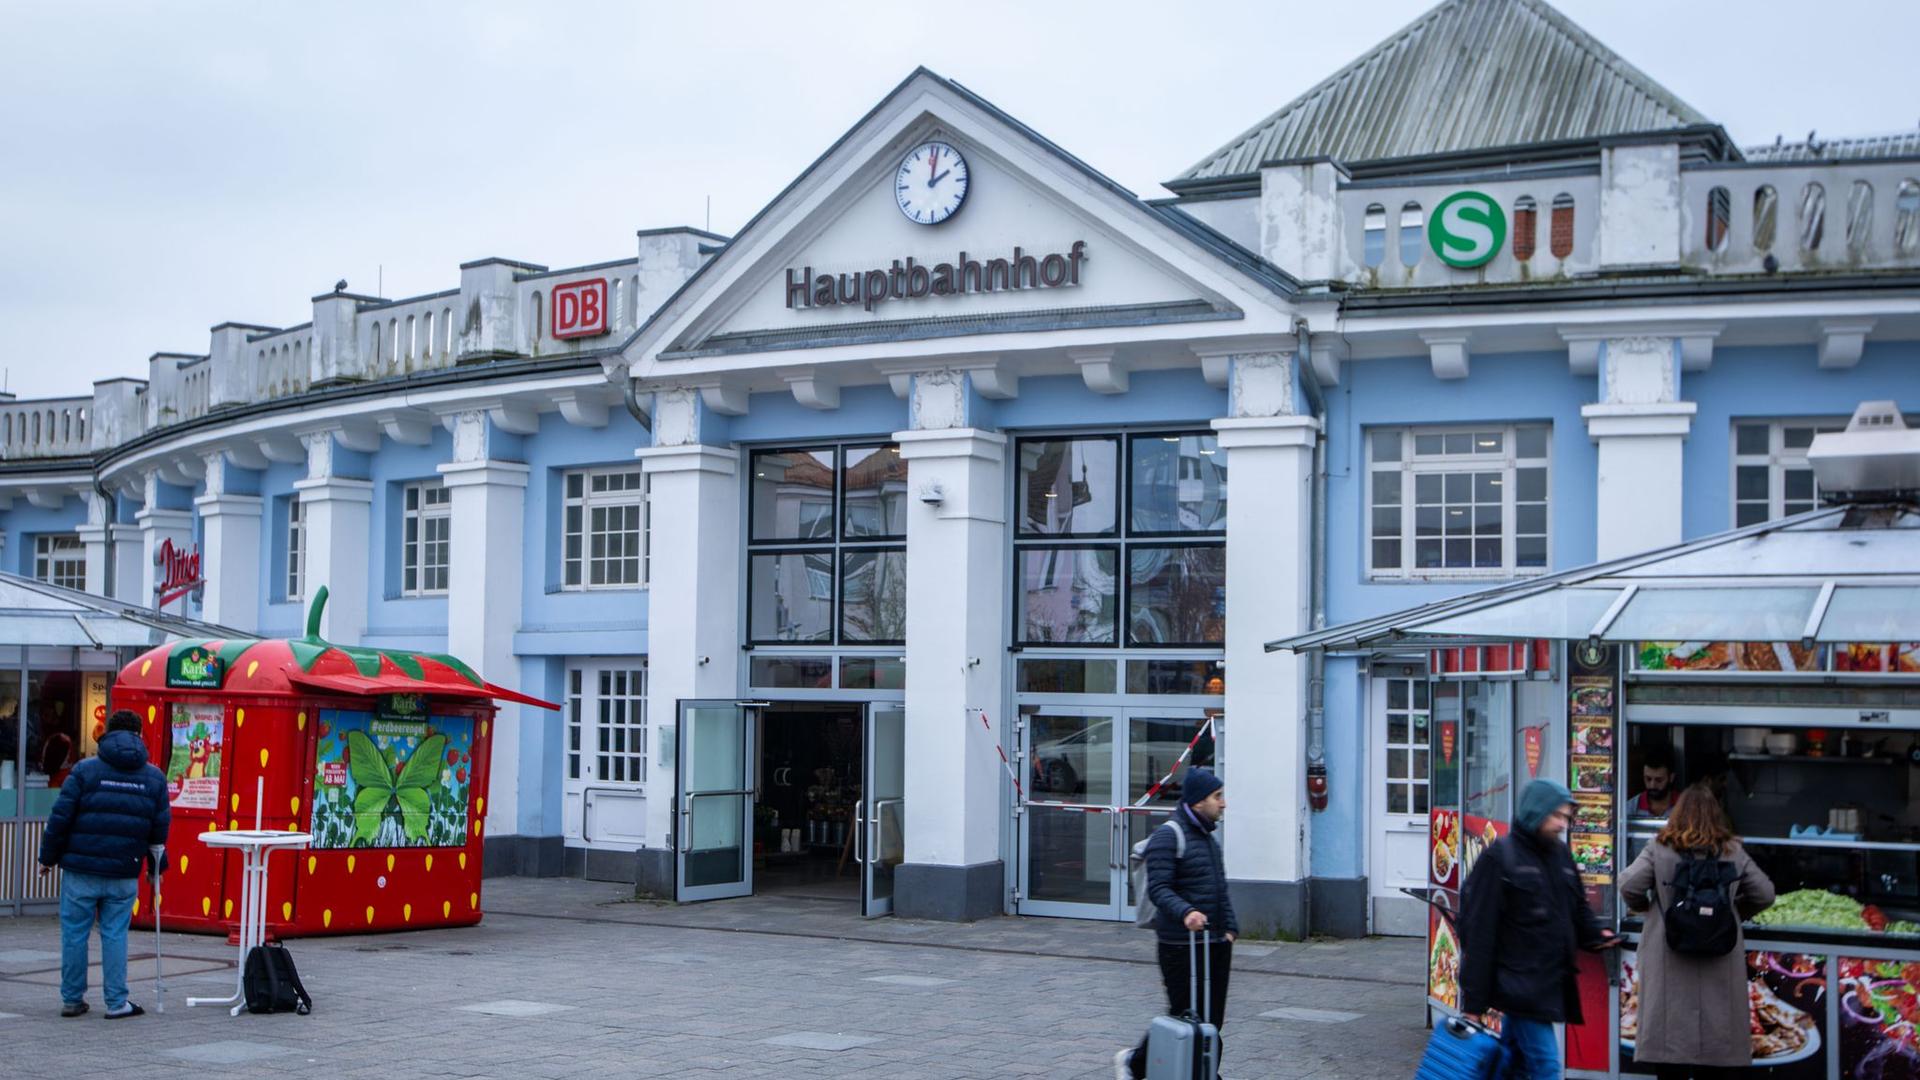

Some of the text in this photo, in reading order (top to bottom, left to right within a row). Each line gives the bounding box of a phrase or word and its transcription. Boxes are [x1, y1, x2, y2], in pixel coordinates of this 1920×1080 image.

[1442, 198, 1494, 261] S
[786, 241, 1086, 311] Hauptbahnhof
[559, 287, 600, 331] DB
[182, 661, 207, 675] Karls
[371, 720, 425, 737] #erdbeerengel
